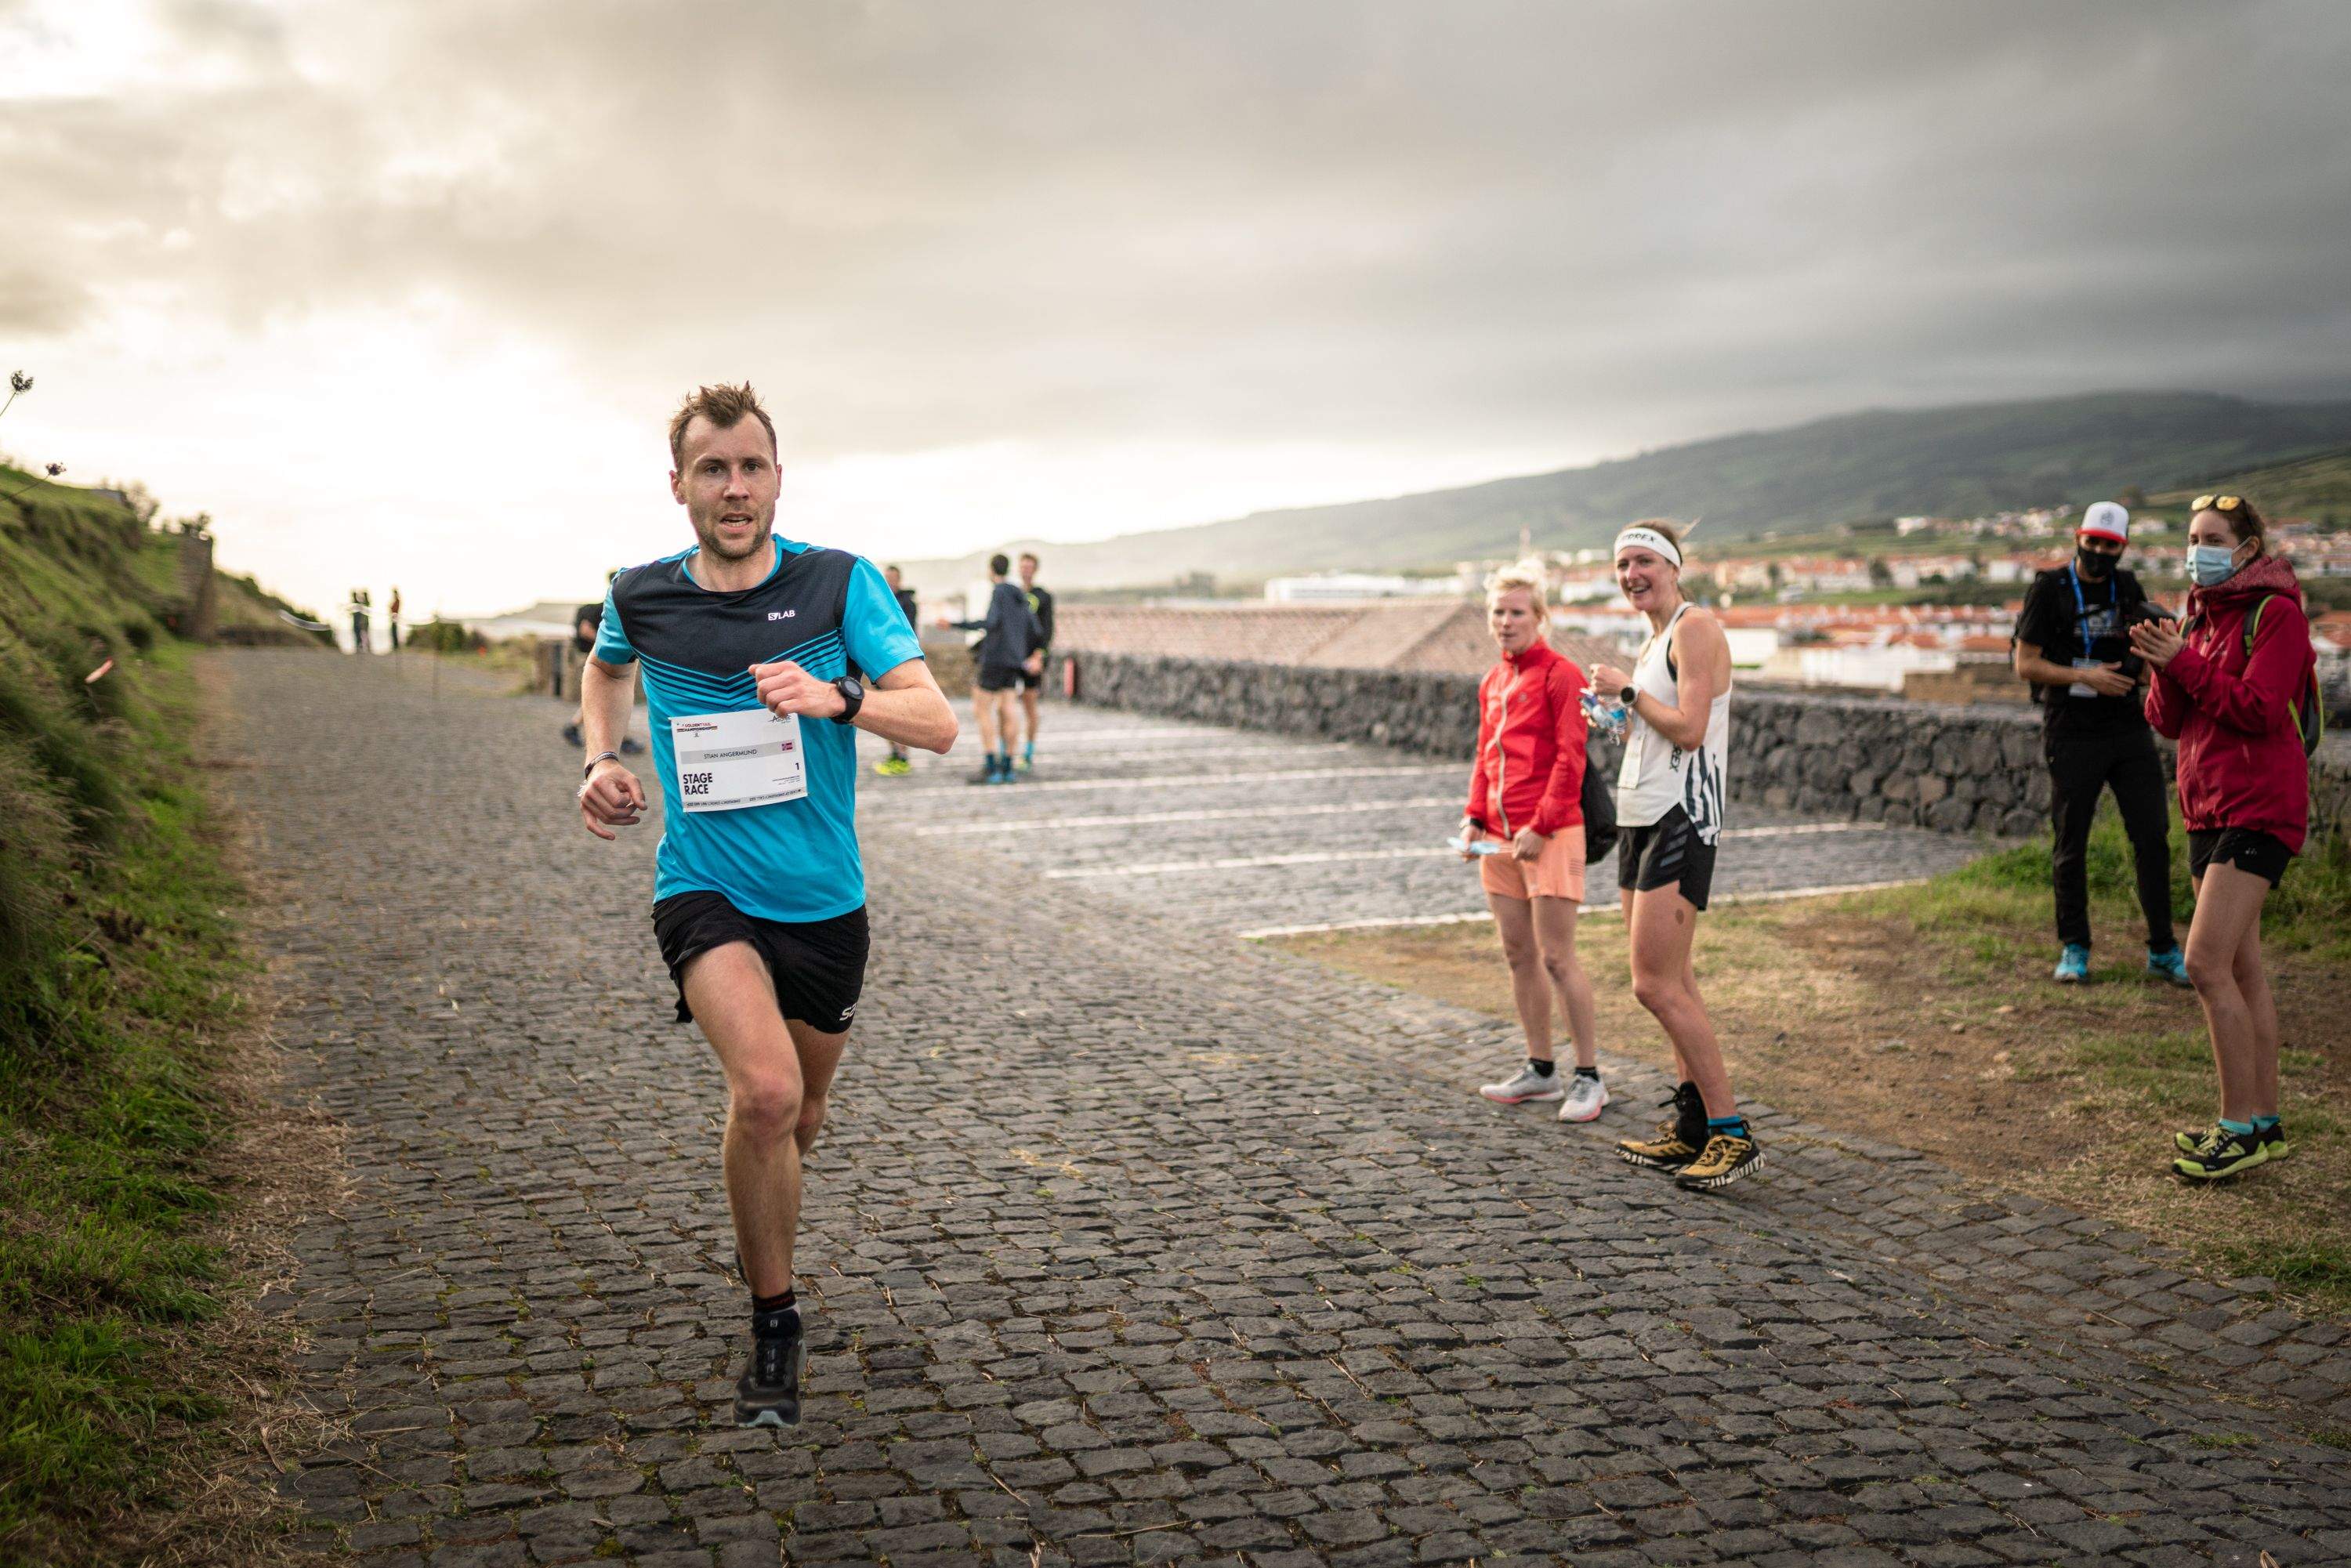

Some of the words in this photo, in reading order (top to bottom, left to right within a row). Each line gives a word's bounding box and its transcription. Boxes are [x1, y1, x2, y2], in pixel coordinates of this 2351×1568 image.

[719, 749, 757, 758] ANGERMUND
[683, 773, 712, 784] STAGE
[684, 784, 709, 795] RACE
